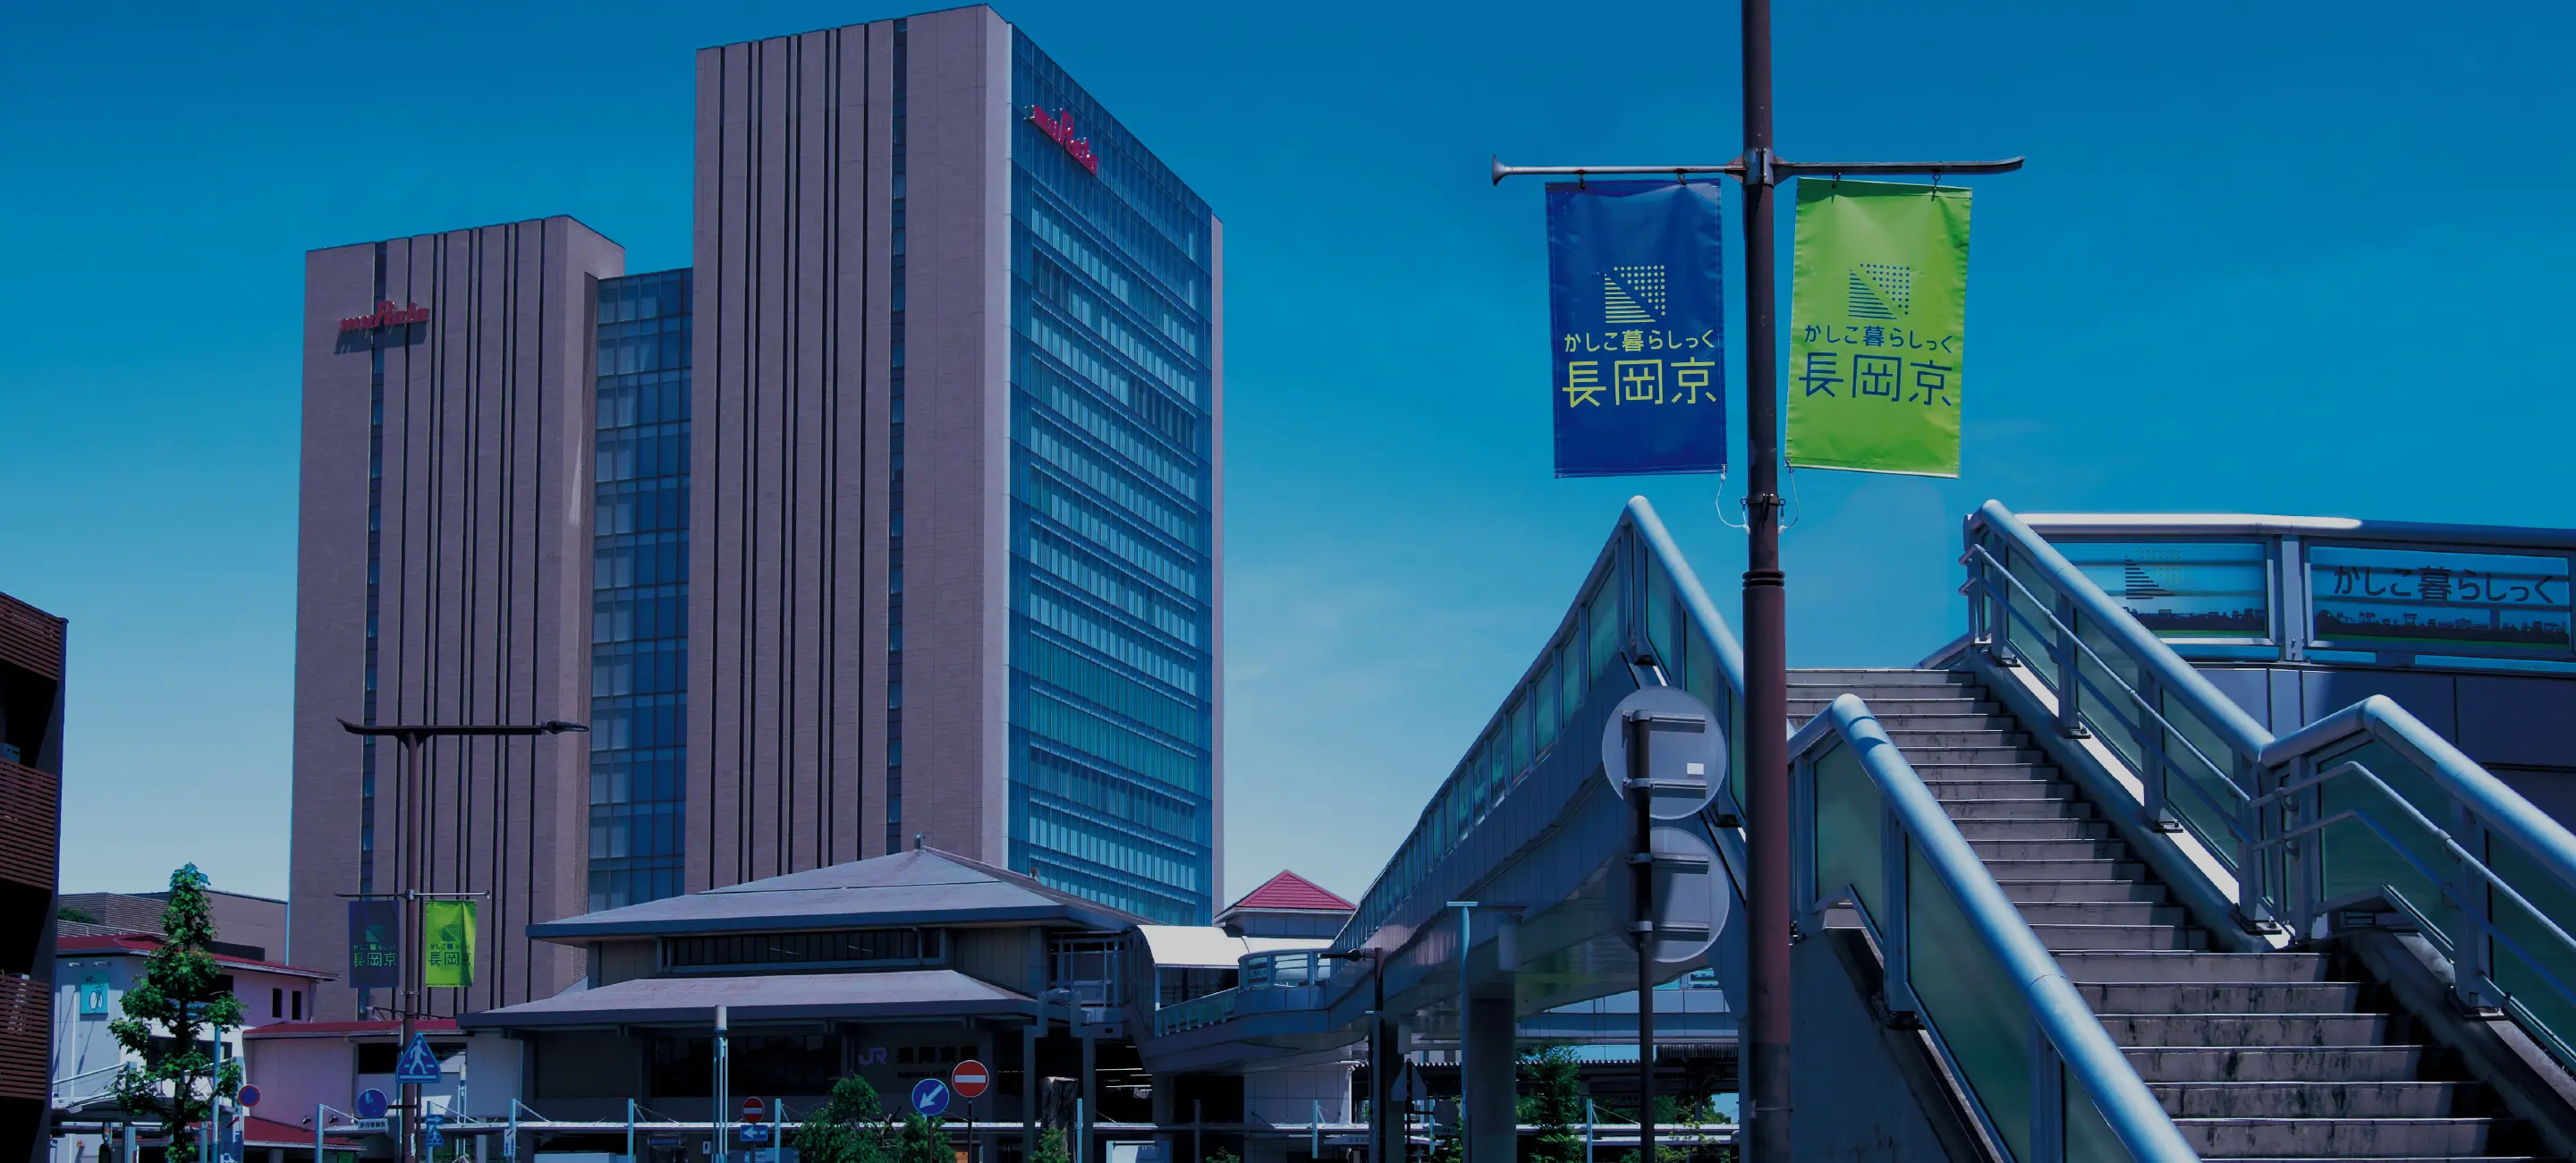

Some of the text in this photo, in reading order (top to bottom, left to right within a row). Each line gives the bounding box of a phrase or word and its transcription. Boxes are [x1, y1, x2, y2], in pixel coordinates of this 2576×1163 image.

[1564, 329, 1715, 352] かしこ暮らしっく
[1804, 325, 1953, 353] かしこ暮らしっく
[1563, 356, 1716, 407] 長岡京
[1799, 352, 1953, 406] 長岡京
[2332, 565, 2555, 605] かしこ暮らしっく
[352, 952, 397, 967] 長岡京
[429, 951, 471, 967] 長岡京
[858, 1046, 888, 1065] JR
